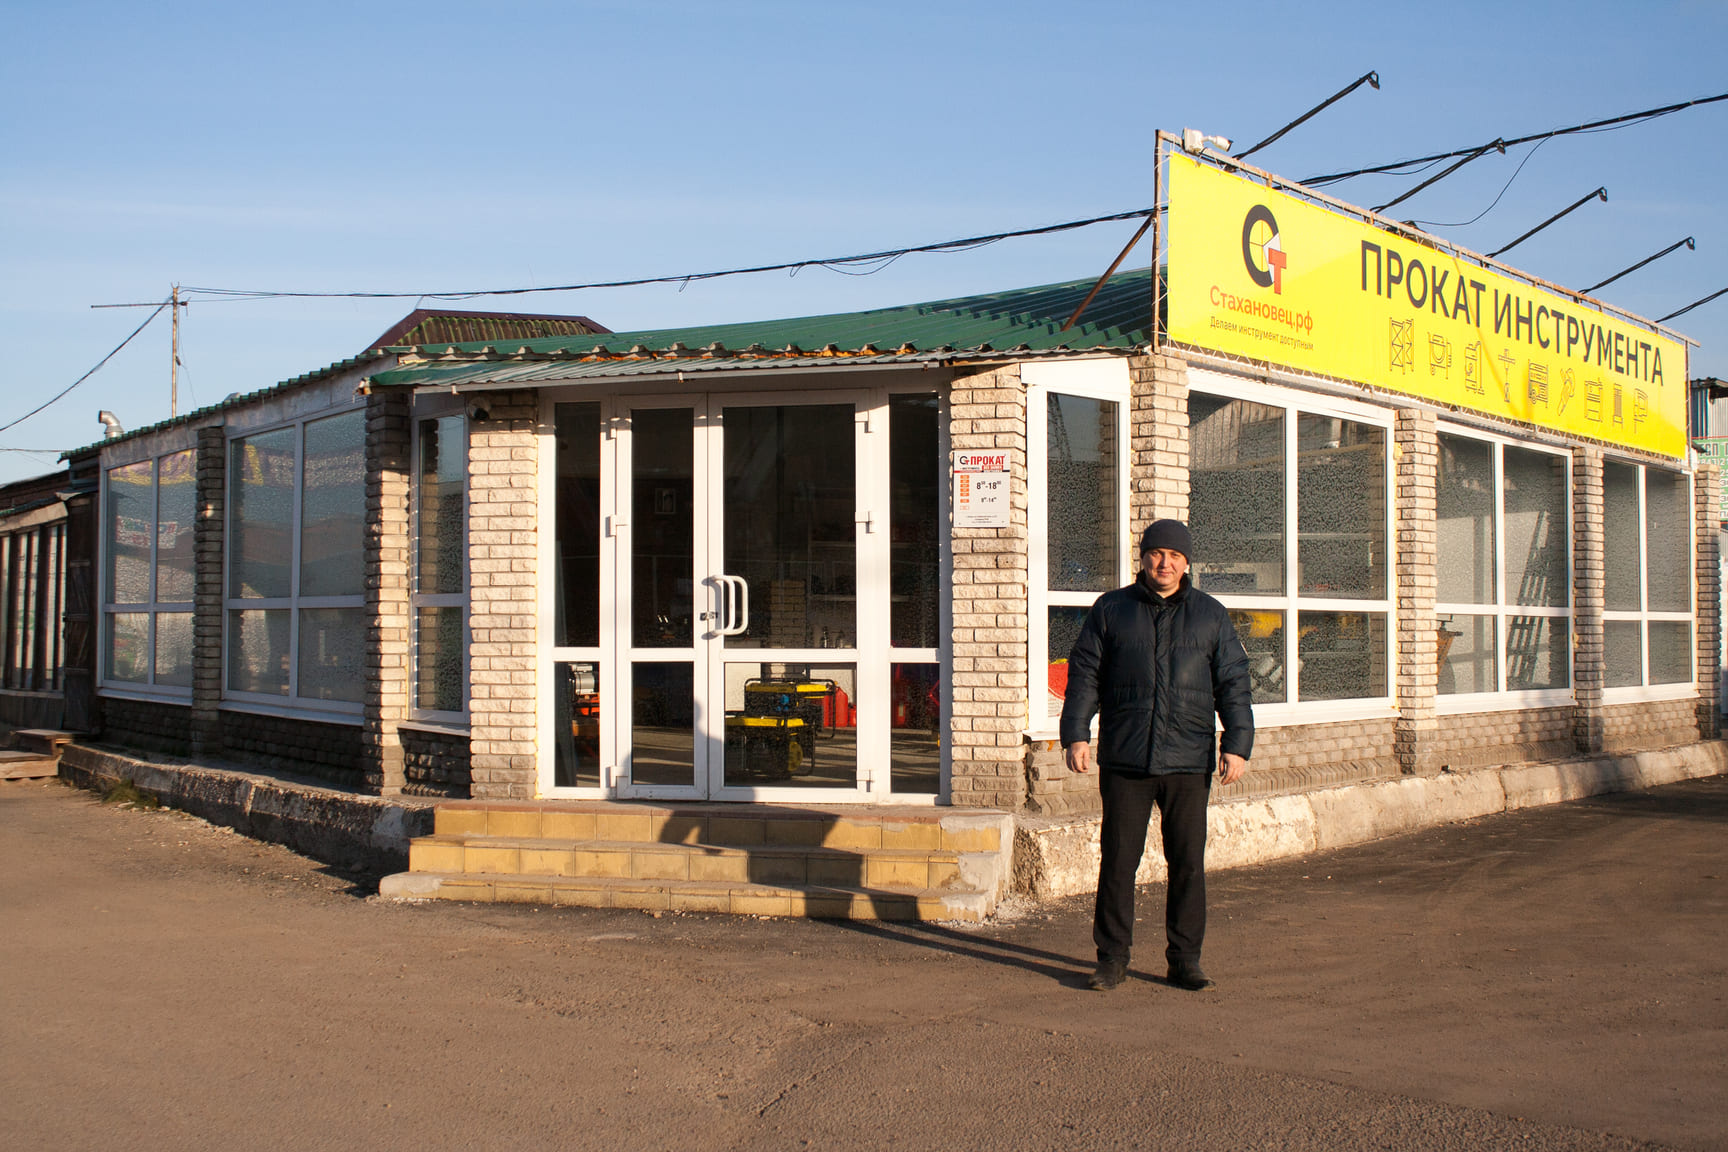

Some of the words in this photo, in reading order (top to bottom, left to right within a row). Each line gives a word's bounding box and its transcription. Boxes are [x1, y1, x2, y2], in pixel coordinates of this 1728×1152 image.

[1210, 285, 1313, 335] Стахановец.рф
[1361, 240, 1486, 328] ПРОКАТ
[1494, 289, 1664, 387] ИНСТРУМЕНТА
[1210, 316, 1238, 333] Делаем
[1239, 325, 1279, 341] инструмент
[1280, 335, 1314, 351] доступным
[970, 456, 1005, 465] ПРОКАТ
